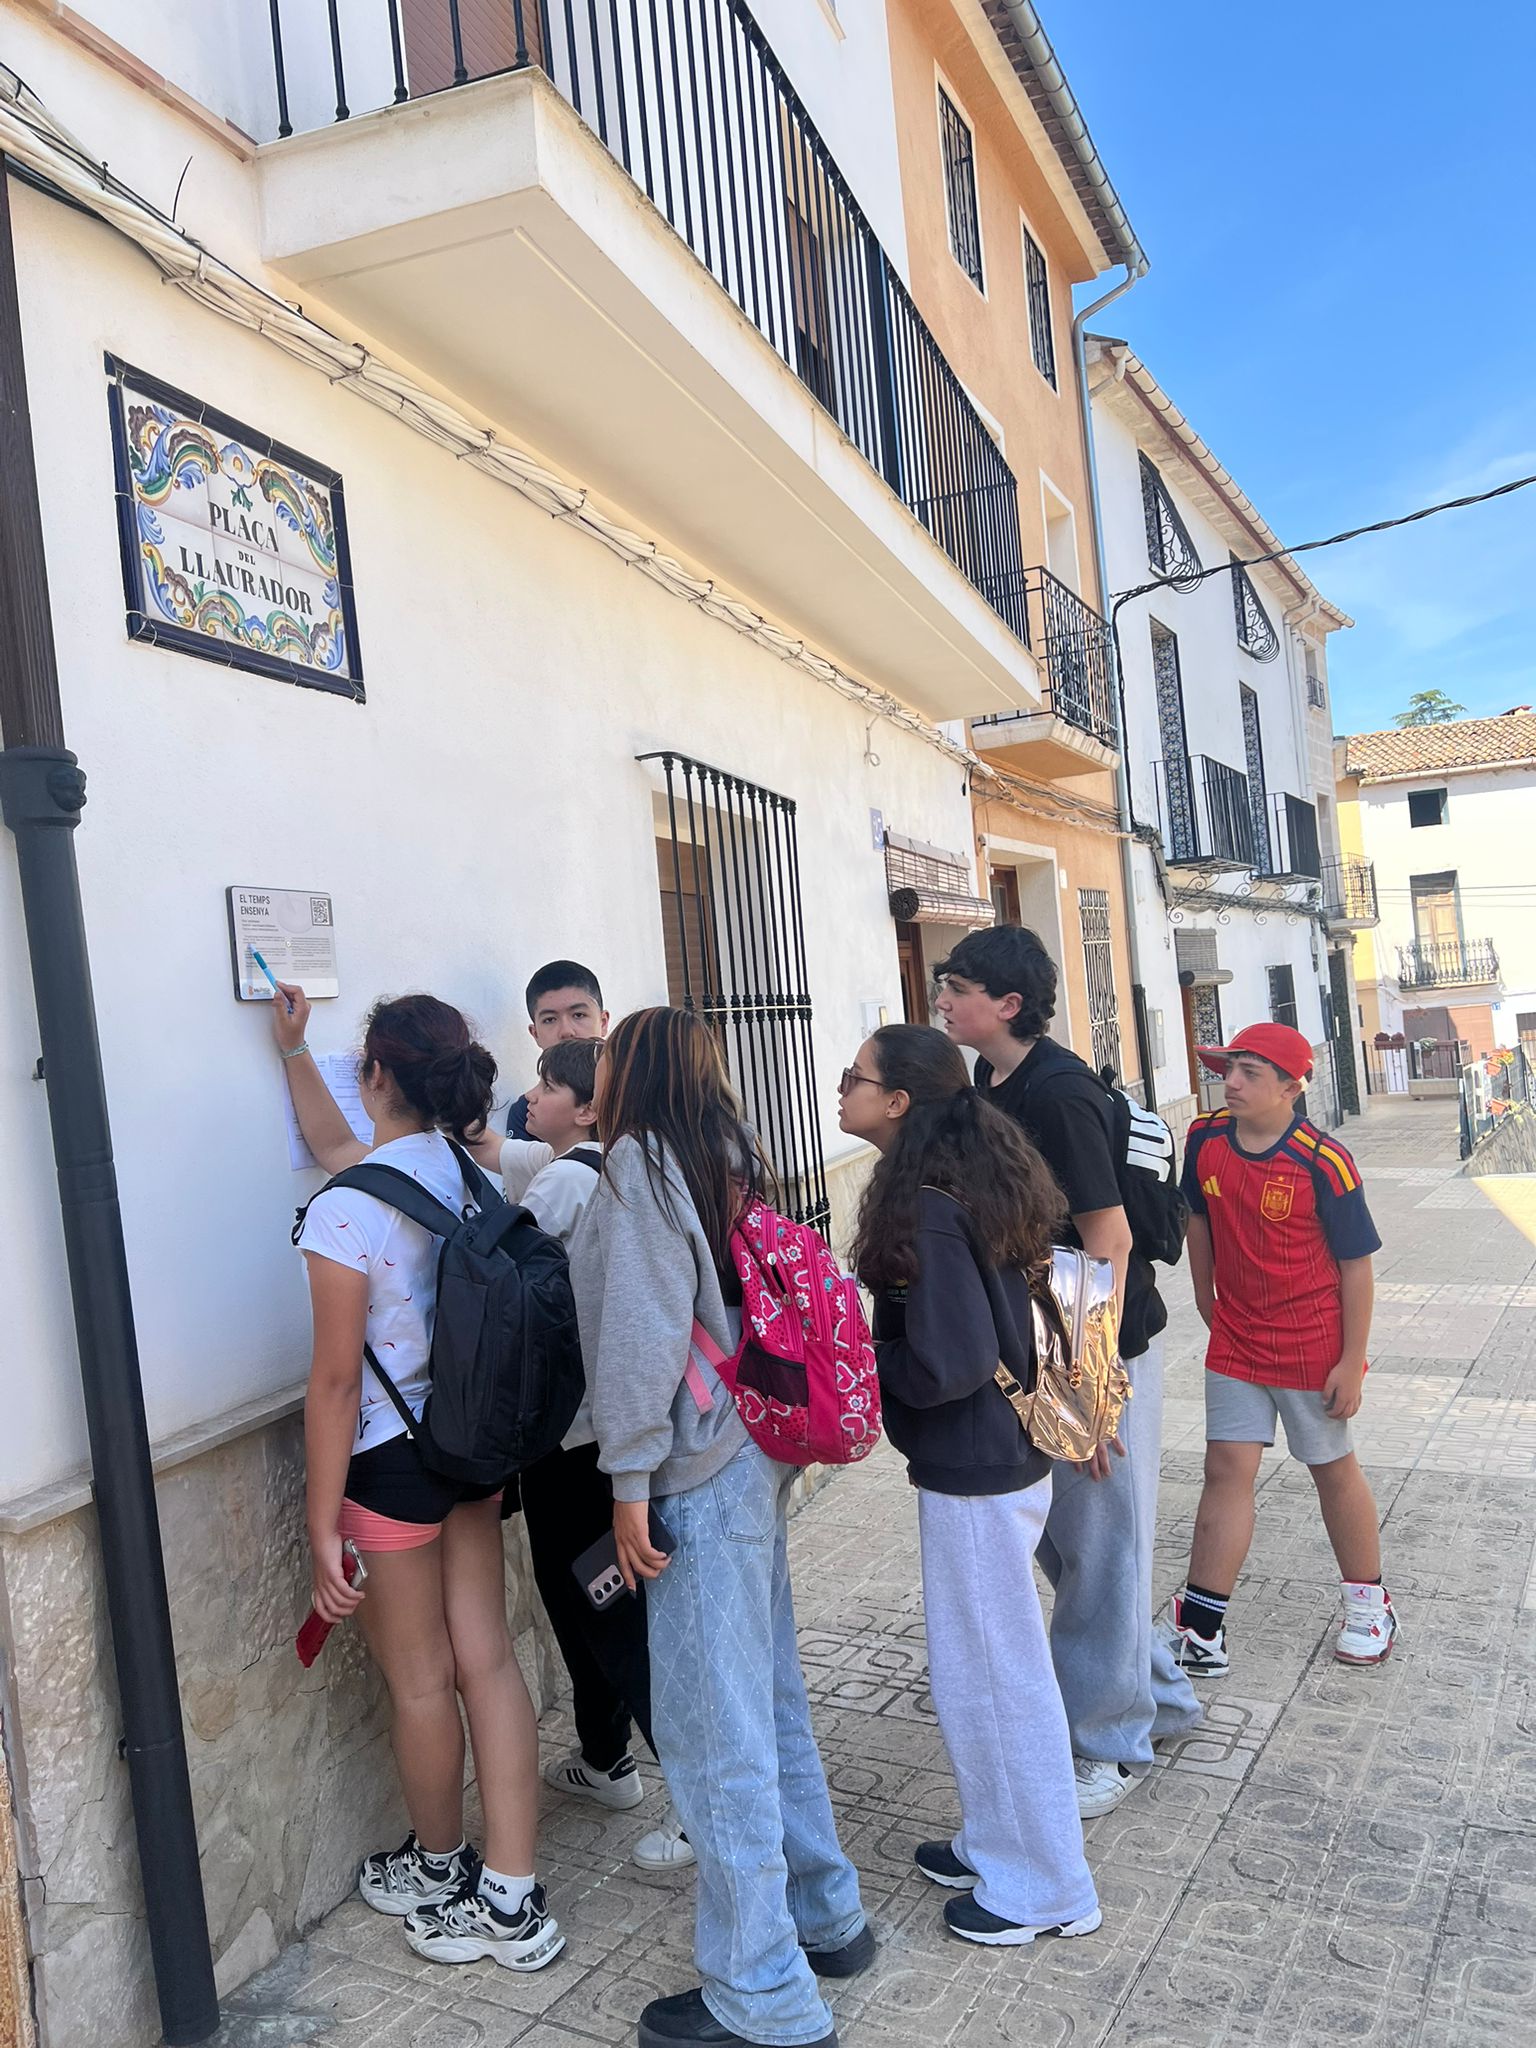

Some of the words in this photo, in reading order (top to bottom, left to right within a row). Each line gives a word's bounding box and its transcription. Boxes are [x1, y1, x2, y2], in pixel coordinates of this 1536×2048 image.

[209, 501, 279, 552] PLAÇA
[238, 550, 256, 566] DEL
[179, 545, 313, 616] LLAURADOR
[240, 893, 247, 903] EL
[248, 894, 270, 904] TEMPS
[240, 906, 270, 916] ENSENYA
[483, 1876, 508, 1895] FILA
